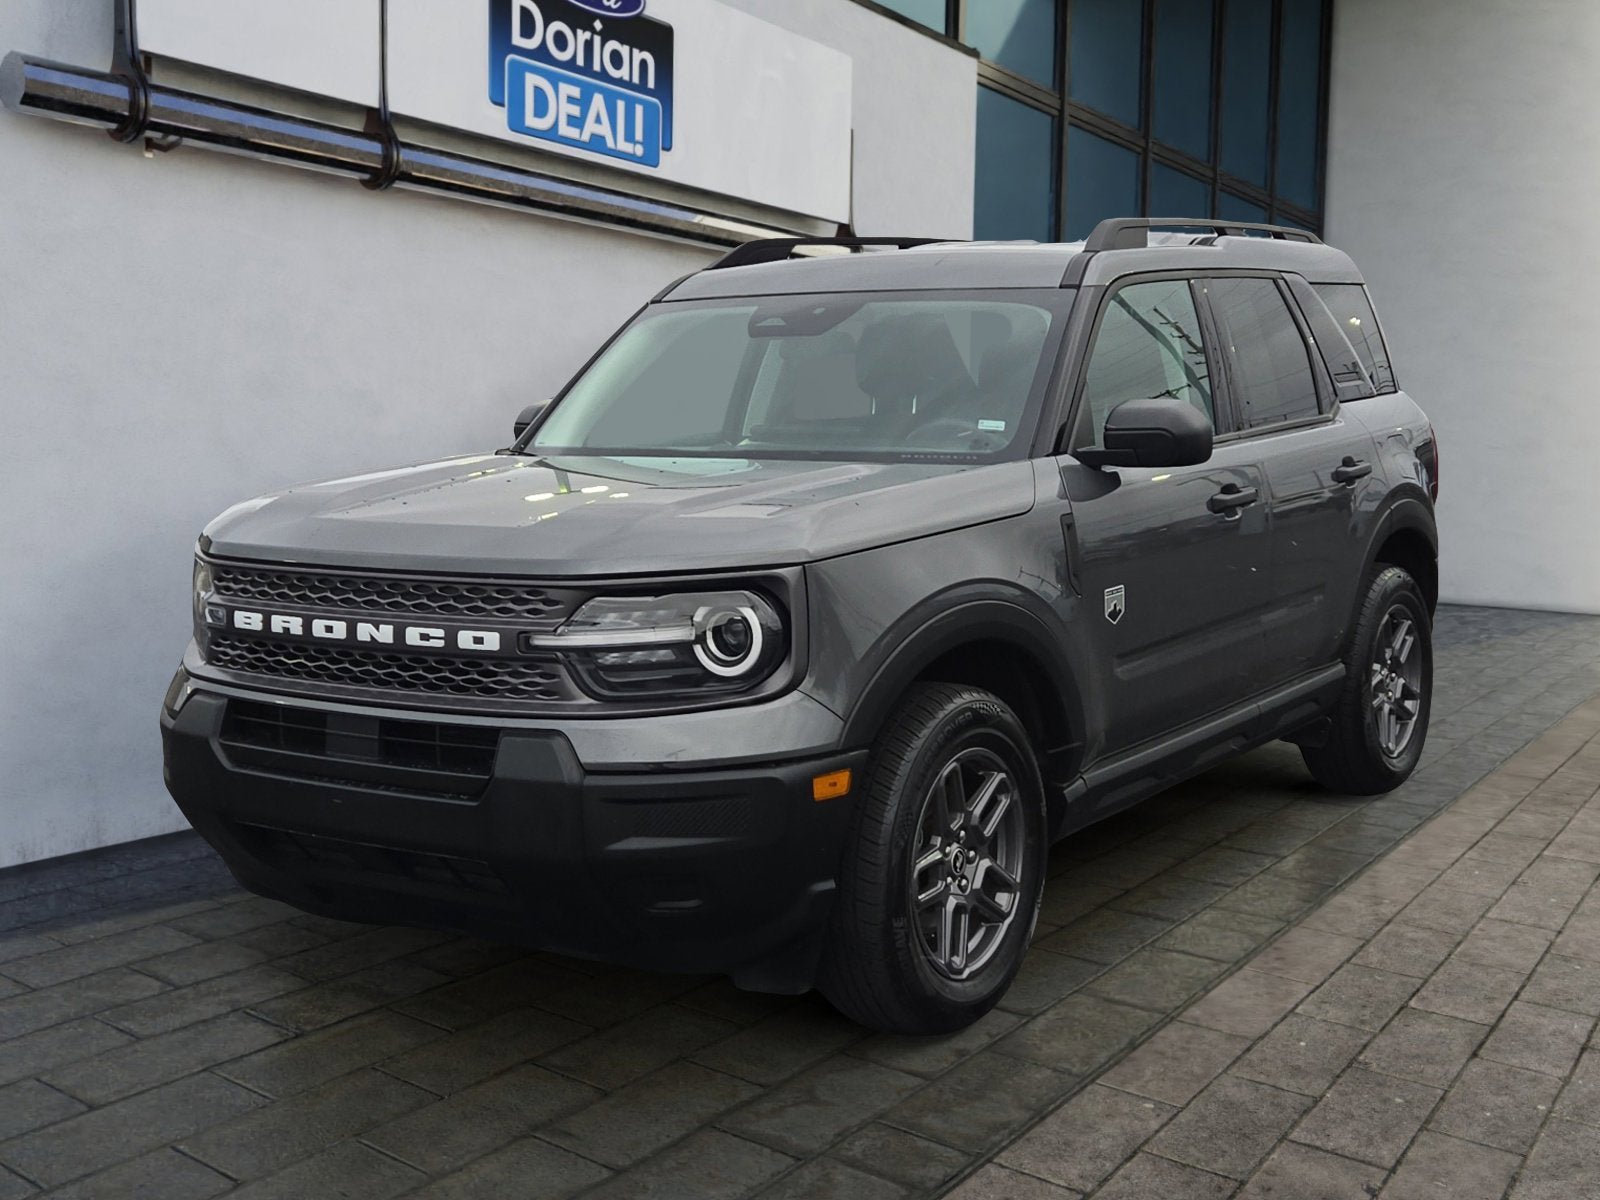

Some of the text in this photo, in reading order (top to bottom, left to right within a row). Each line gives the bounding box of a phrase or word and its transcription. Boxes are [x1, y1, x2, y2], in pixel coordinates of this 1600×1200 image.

[511, 0, 655, 89] Dorian
[525, 72, 644, 157] DEAL!
[233, 610, 500, 650] BRONCO
